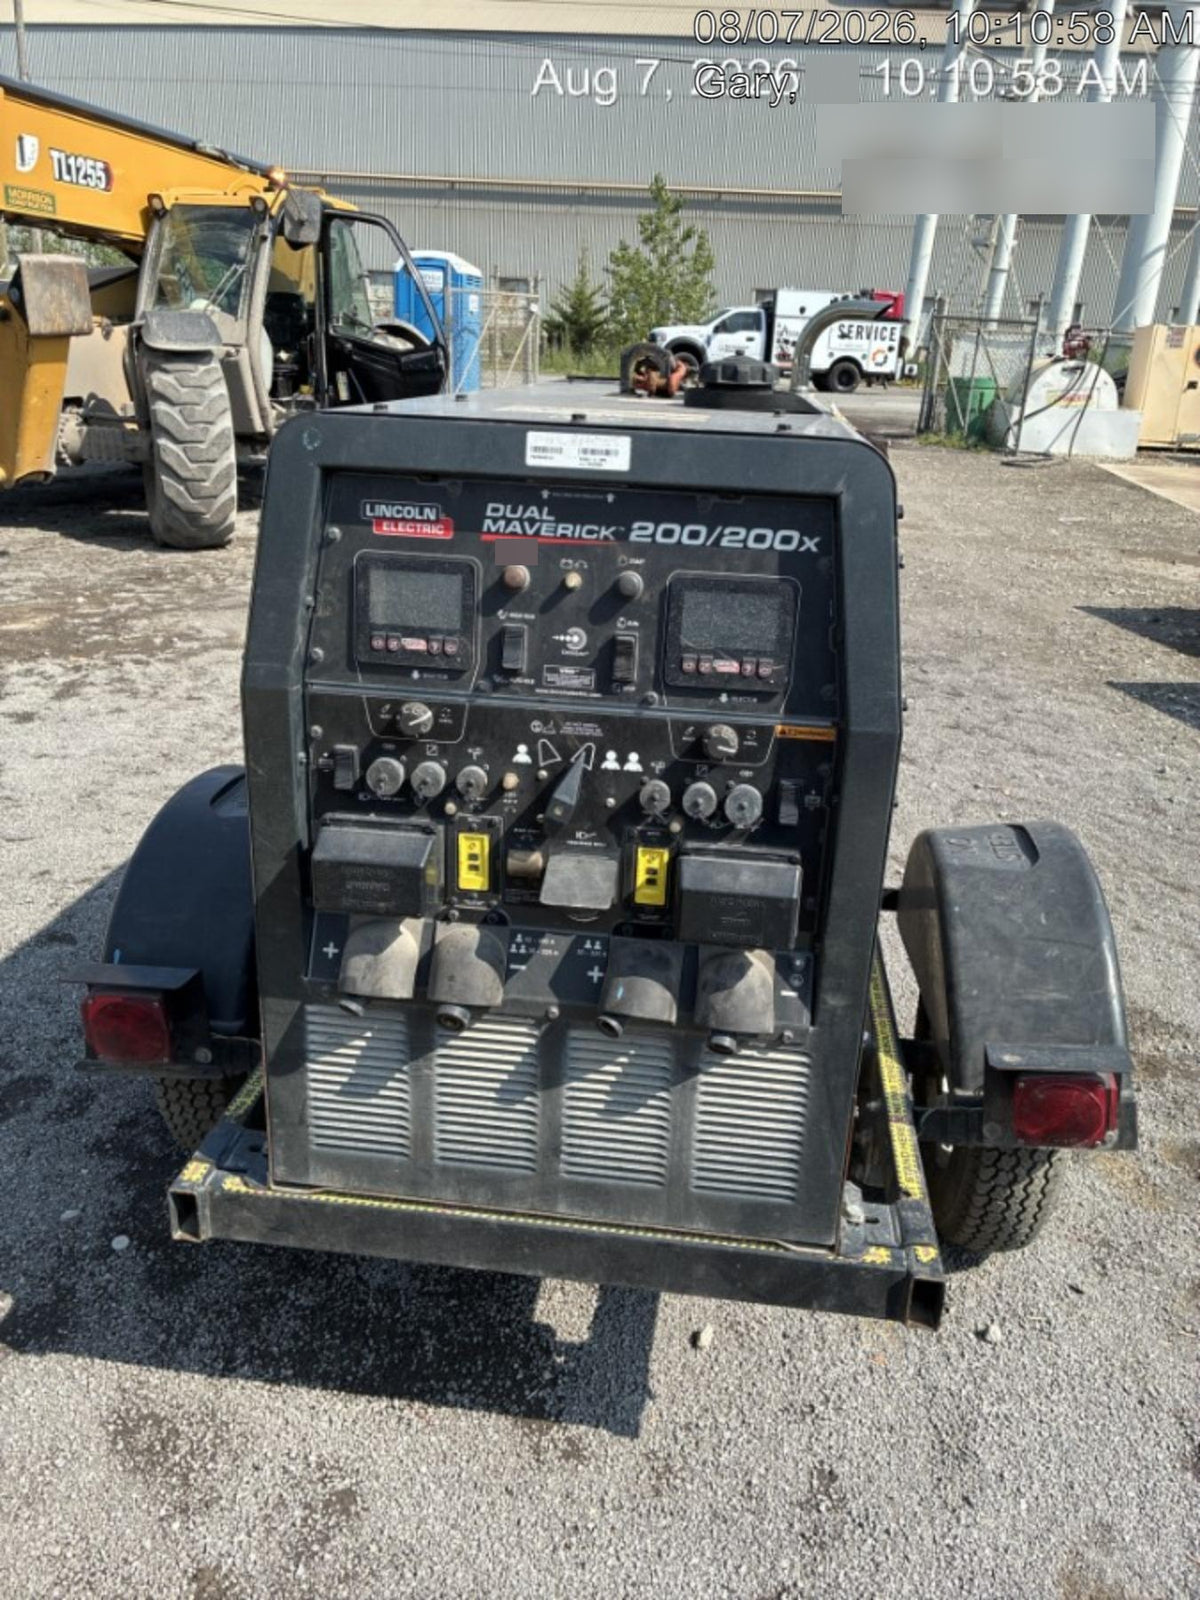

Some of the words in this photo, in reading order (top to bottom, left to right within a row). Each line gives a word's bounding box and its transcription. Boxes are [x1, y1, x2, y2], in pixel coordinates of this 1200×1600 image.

[50, 148, 107, 189] TL1255
[838, 322, 897, 342] SERVICE
[365, 504, 437, 520] LINCOLN
[485, 503, 556, 521] DUAL
[382, 521, 445, 535] ELECTRIC
